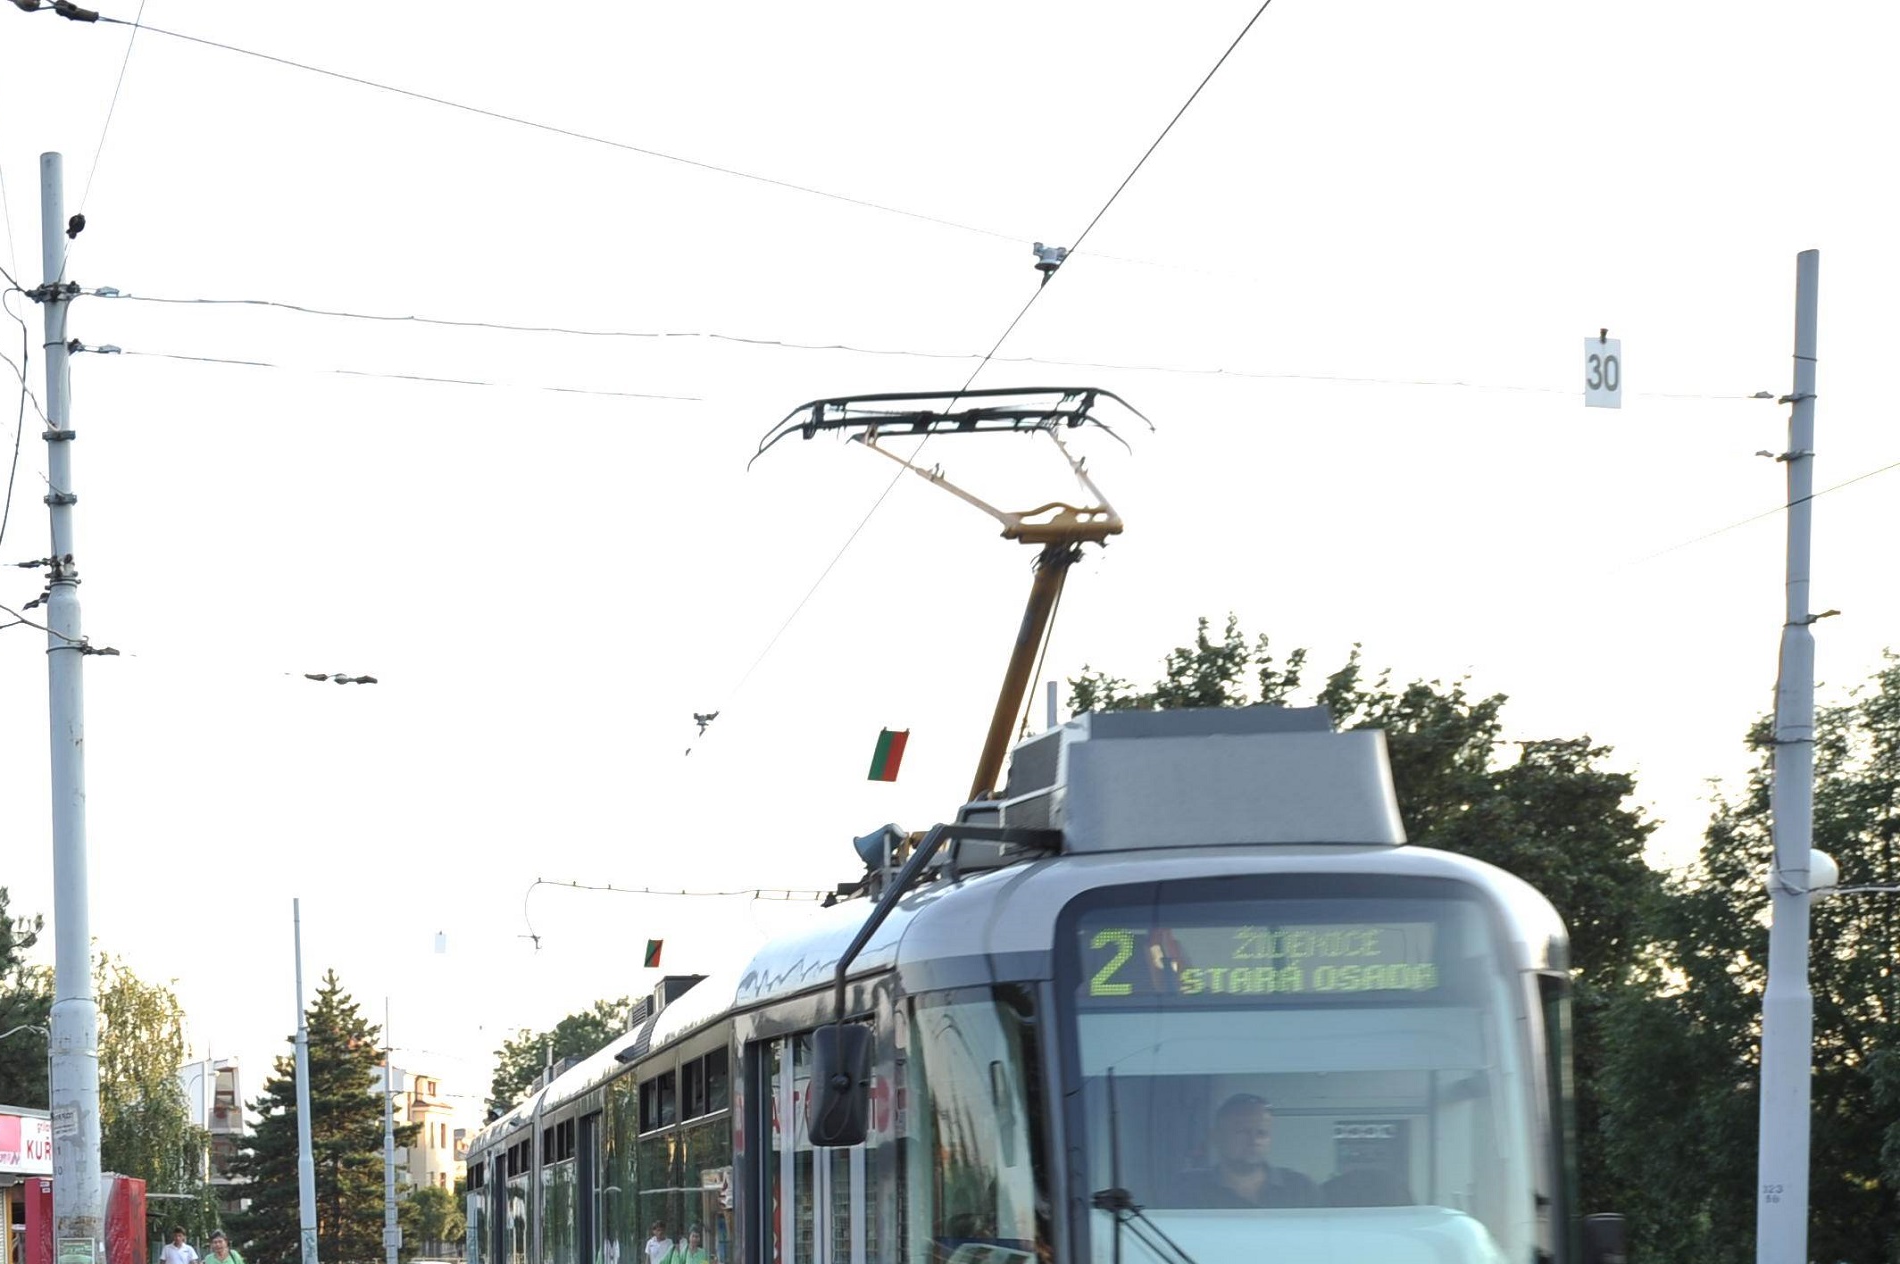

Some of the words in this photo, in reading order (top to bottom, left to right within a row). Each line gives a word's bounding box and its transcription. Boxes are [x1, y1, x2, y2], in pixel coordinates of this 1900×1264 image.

[1587, 354, 1619, 391] 30
[1089, 928, 1135, 997] 2
[1180, 960, 1305, 995] STARÁ
[1311, 962, 1439, 992] OSADA
